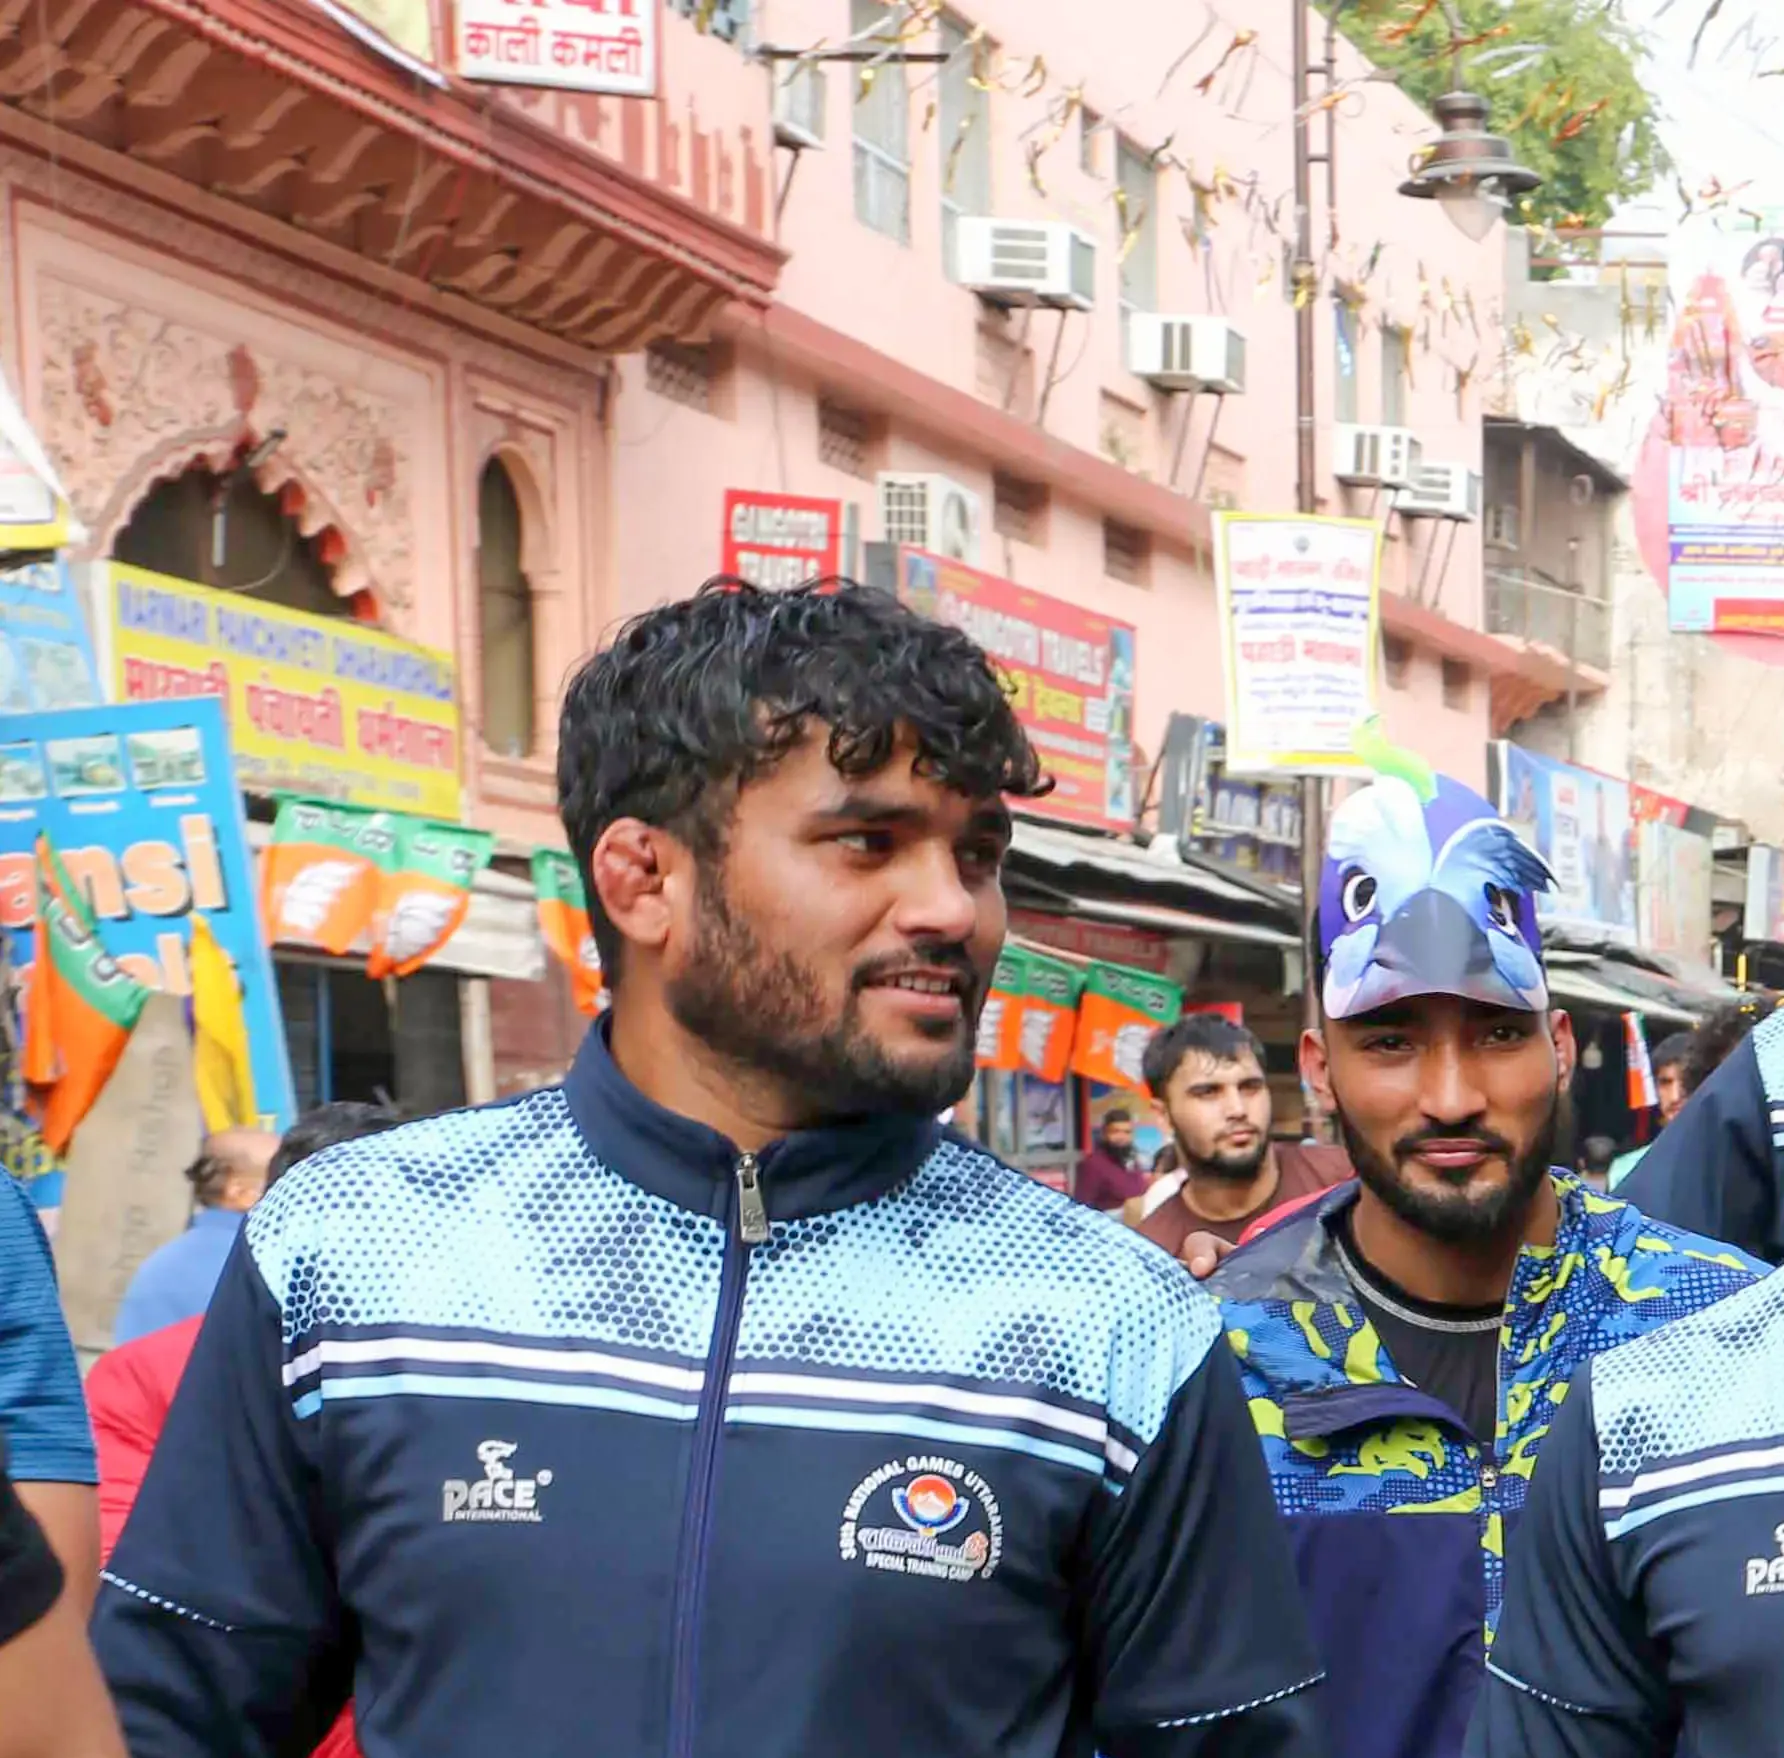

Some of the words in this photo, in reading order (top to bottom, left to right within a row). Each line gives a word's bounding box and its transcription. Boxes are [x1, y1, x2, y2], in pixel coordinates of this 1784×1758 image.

[465, 16, 541, 66] काली
[552, 26, 643, 77] कमली
[443, 1478, 537, 1522] PACE
[843, 1459, 906, 1521] NATIONAL
[906, 1455, 964, 1480] GAMES
[963, 1471, 1004, 1579] UTTARAKHAND
[866, 1551, 907, 1573] SPECIAL
[906, 1556, 950, 1579] TRAINING
